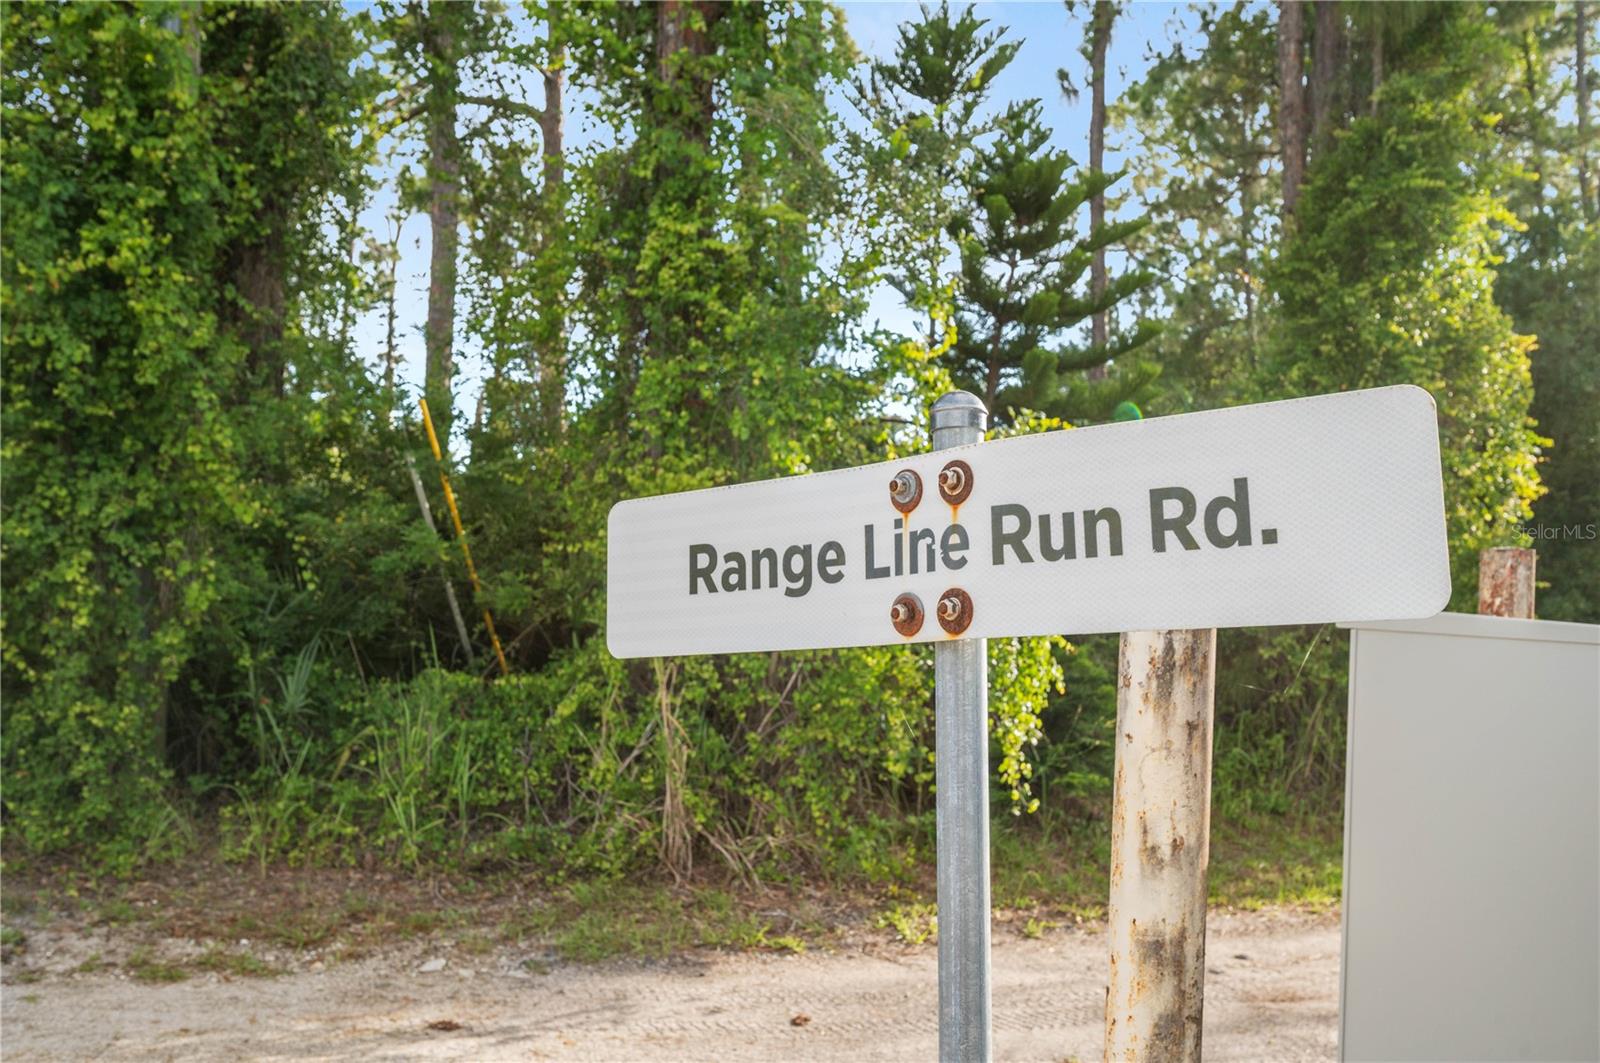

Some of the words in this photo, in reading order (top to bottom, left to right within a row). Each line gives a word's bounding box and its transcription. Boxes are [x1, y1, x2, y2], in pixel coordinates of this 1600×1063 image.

[688, 538, 846, 597] Range
[864, 519, 970, 580] Line
[991, 504, 1123, 565] Run
[1149, 477, 1278, 553] Rd.
